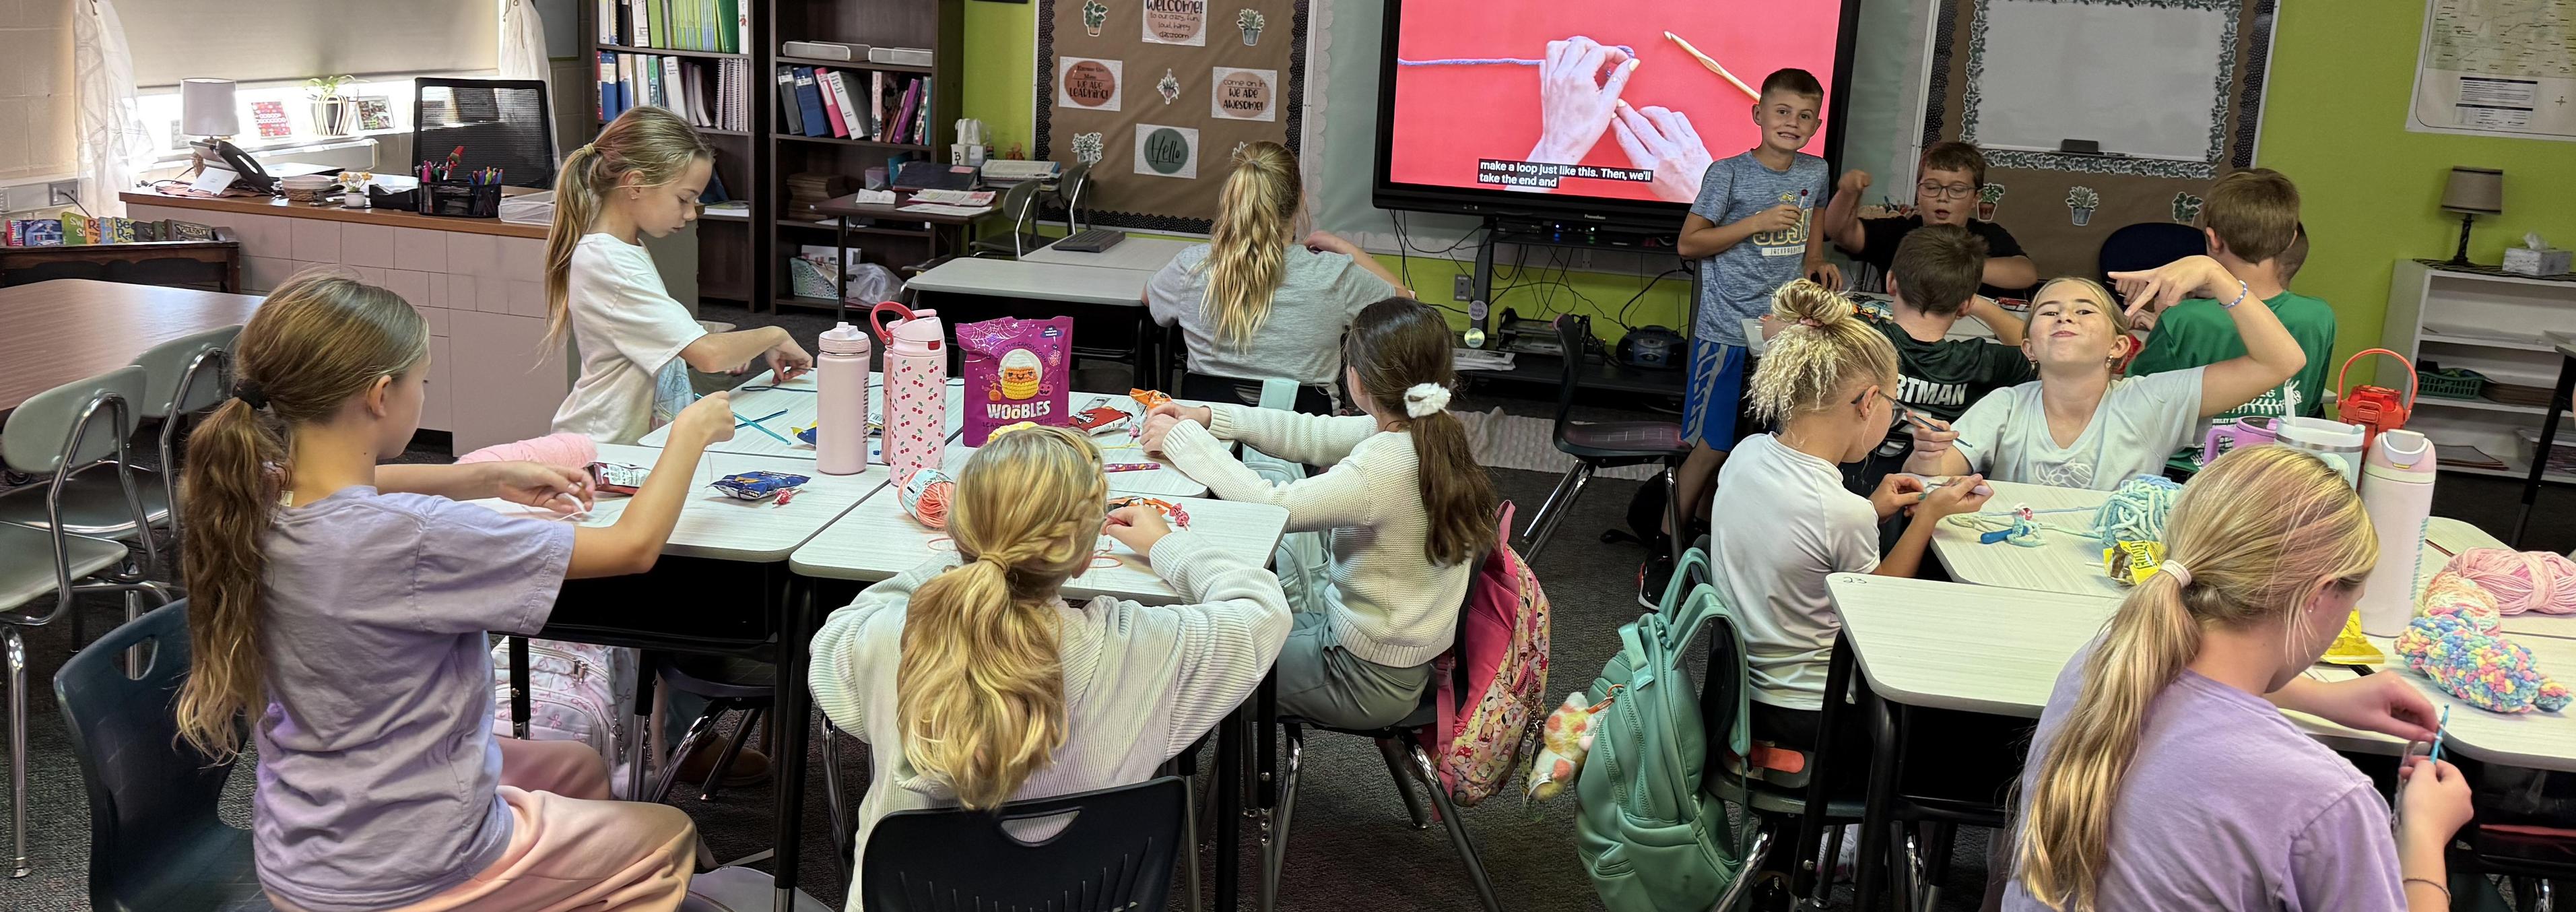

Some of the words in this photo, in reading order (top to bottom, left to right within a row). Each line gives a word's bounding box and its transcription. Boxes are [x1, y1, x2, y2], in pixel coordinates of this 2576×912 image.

[1152, 134, 1181, 164] Hello
[1480, 161, 1507, 171] make
[1508, 164, 1515, 172] a
[1517, 162, 1538, 174] loop
[1539, 164, 1557, 175] just
[1559, 165, 1577, 176] like
[1578, 167, 1599, 177] this.
[1601, 168, 1628, 181] Then,
[1629, 171, 1651, 181] we'll
[1480, 173, 1500, 183] take
[1502, 174, 1516, 184] the
[1519, 176, 1537, 185] end
[1539, 178, 1557, 187] and
[987, 400, 1051, 420] WOOBLES
